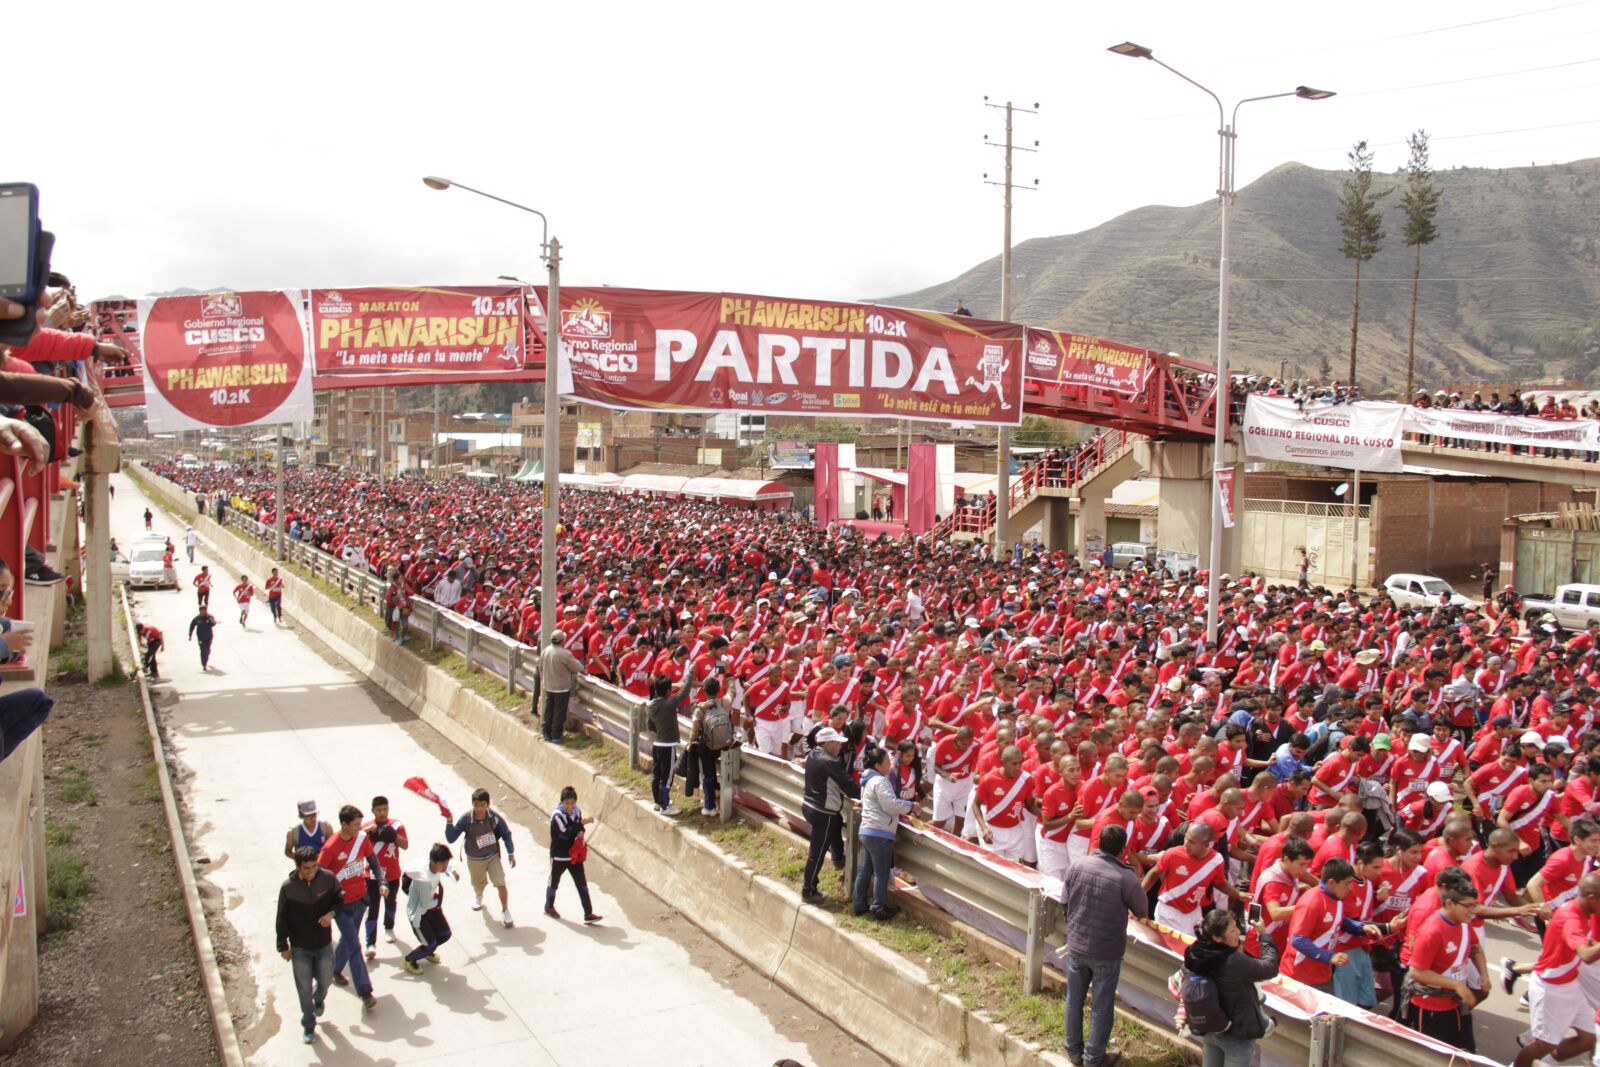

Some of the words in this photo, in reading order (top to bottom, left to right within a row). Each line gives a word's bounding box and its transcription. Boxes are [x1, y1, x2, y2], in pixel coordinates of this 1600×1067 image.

[360, 301, 419, 312] MARATON
[472, 296, 519, 316] 10.2K
[184, 319, 225, 329] Gobierno
[226, 316, 264, 330] Regional
[720, 297, 864, 333] PHAWARISUN
[866, 314, 907, 337] 10.2K
[184, 327, 265, 345] CUSCO
[320, 316, 519, 349] PHAWARISUN
[592, 339, 637, 354] Regional
[1068, 342, 1144, 369] PHAWARISUN
[360, 351, 388, 364] meta
[391, 349, 415, 364] está
[417, 352, 431, 363] en
[435, 349, 446, 363] tu
[568, 346, 638, 372] USCO
[654, 328, 960, 395] PARTIDA
[167, 363, 288, 391] PHAWARISUN
[210, 389, 251, 405] 10.2K
[728, 389, 748, 401] Real
[896, 397, 917, 411] meta
[920, 399, 938, 413] está
[940, 402, 950, 413] en
[953, 401, 962, 415] tu
[1313, 417, 1350, 427] CUSCO
[1248, 425, 1293, 439] GOBIERNO
[1295, 430, 1341, 444] REGIONAL
[1344, 435, 1361, 446] DEL
[1363, 437, 1394, 449] CUSCO
[1285, 444, 1329, 456] Caminemos
[1330, 449, 1355, 458] juntos
[1389, 896, 1411, 908] 9577
